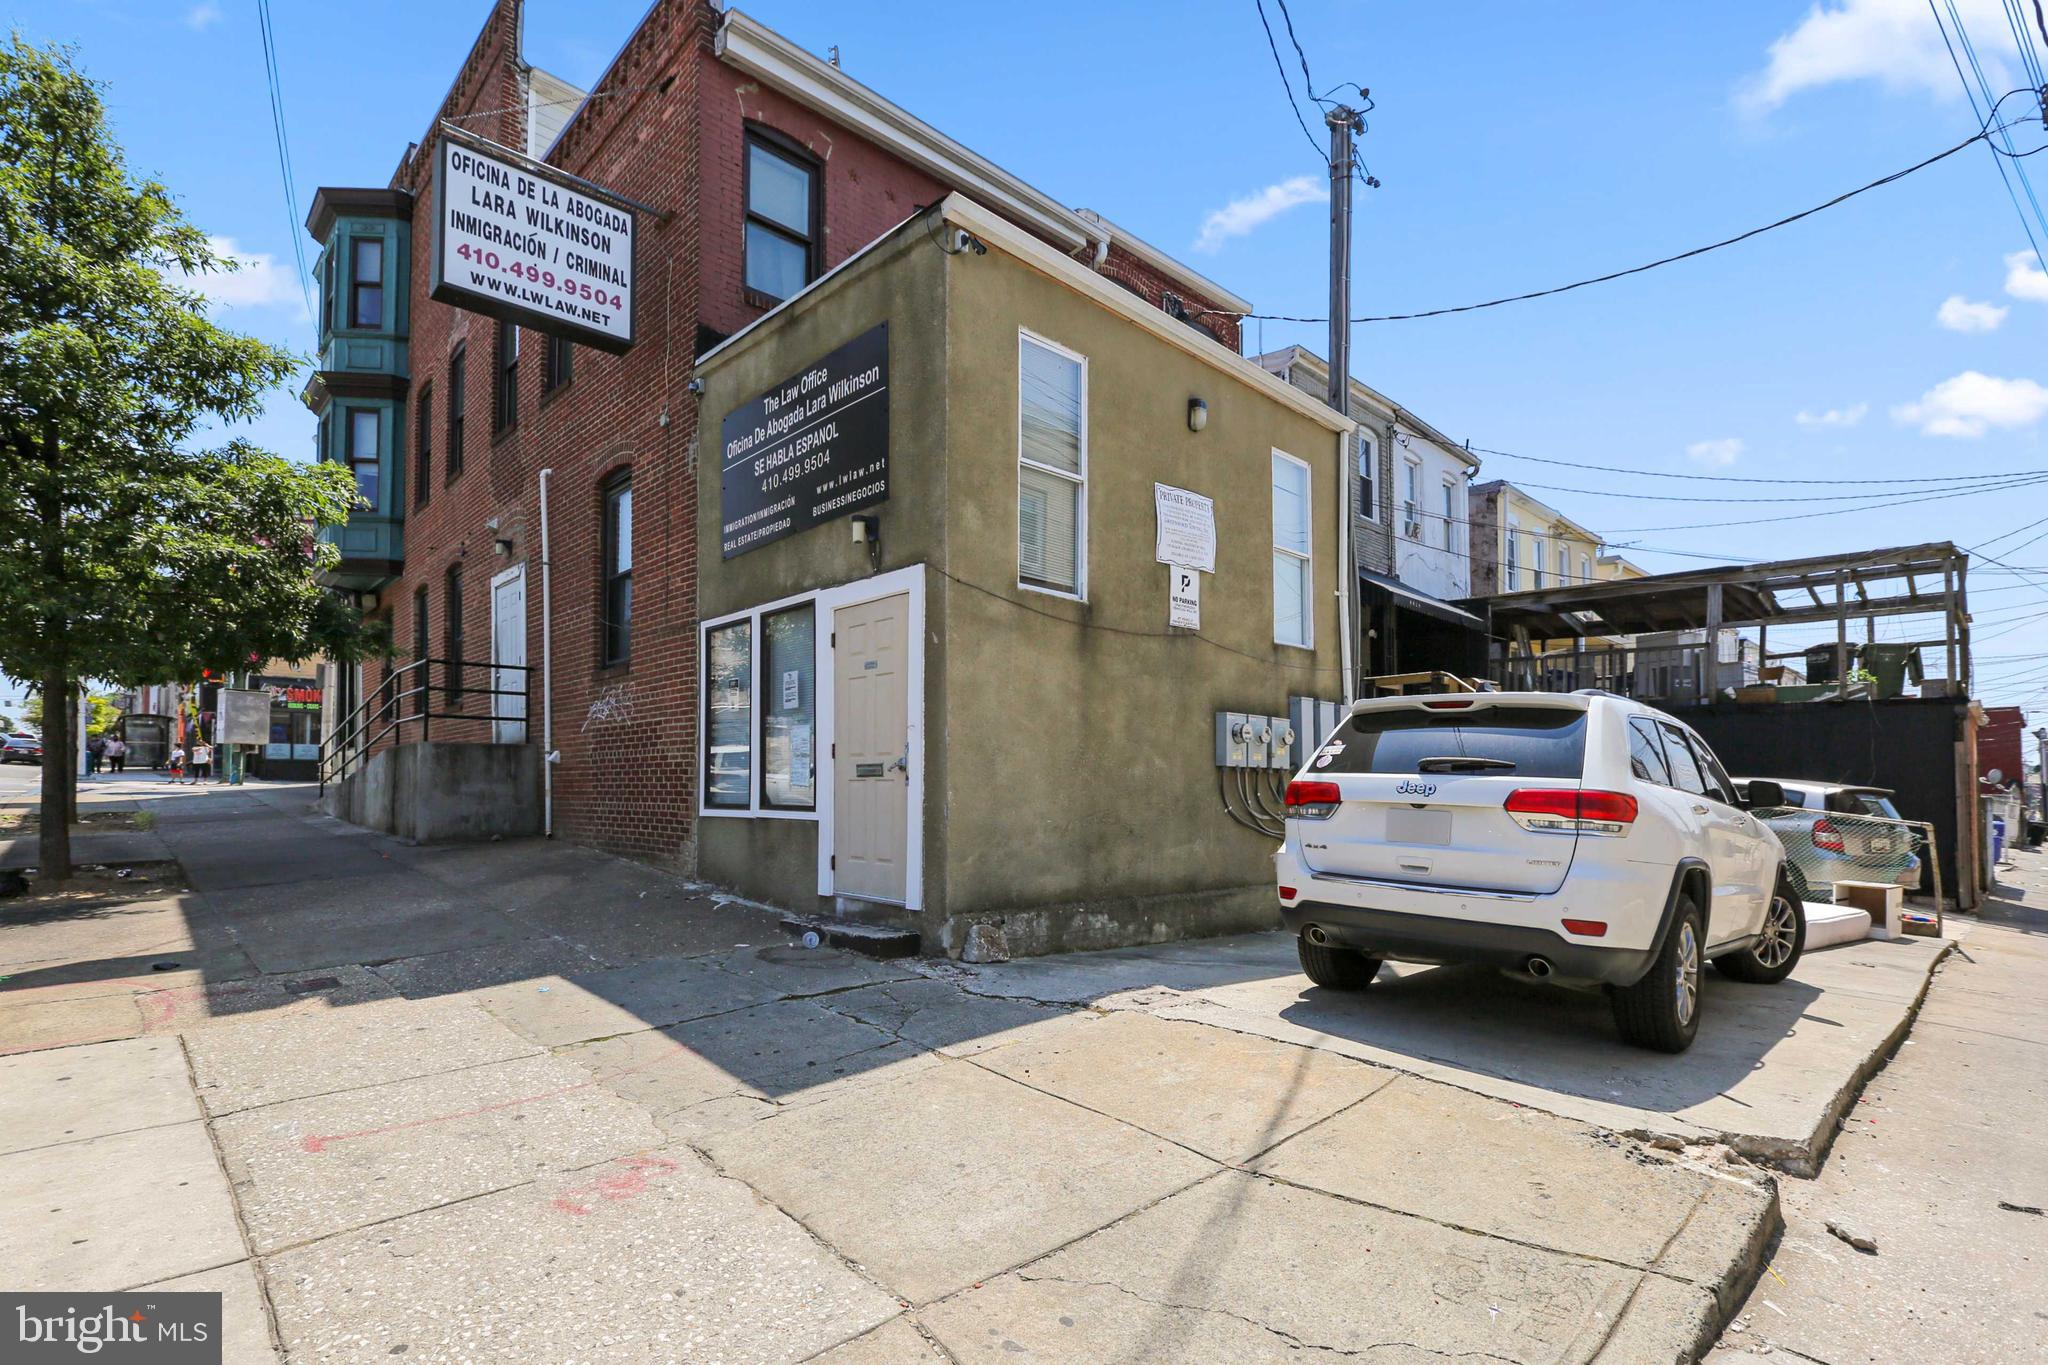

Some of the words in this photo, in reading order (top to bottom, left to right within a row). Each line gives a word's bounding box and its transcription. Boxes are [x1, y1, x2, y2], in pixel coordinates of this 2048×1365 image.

[451, 151, 510, 191] OFICINA
[518, 177, 535, 200] DE
[542, 186, 559, 210] LA
[566, 197, 629, 236] ABOGADA
[471, 185, 517, 220] LARA
[525, 205, 611, 255] WILKINSON
[451, 209, 546, 260] INMIGRACIÓN
[566, 252, 627, 288] CRIMINAL
[457, 243, 623, 311] 410.499.9504
[470, 271, 610, 327] WWW.LWLAW.NET
[726, 434, 753, 459] Oficina
[754, 427, 765, 445] De
[766, 403, 804, 438] Abogada
[806, 394, 827, 417] Lara
[828, 365, 880, 404] Wilkinson
[763, 398, 780, 415] The
[781, 384, 800, 406] Law
[801, 367, 828, 394] Office
[754, 458, 765, 477] SE
[766, 444, 794, 471] HABLA
[761, 449, 830, 492] 410.499.9504
[816, 457, 885, 495] www.lwlaw.net
[812, 479, 886, 517] BUSINESS/NEGOCIOS
[1159, 489, 1183, 505] PRIVATE
[724, 539, 737, 552] REAL
[738, 518, 790, 546] ESTATE/PROPIEDAD
[1179, 597, 1197, 606] PARKING
[1396, 780, 1436, 797] Jeep
